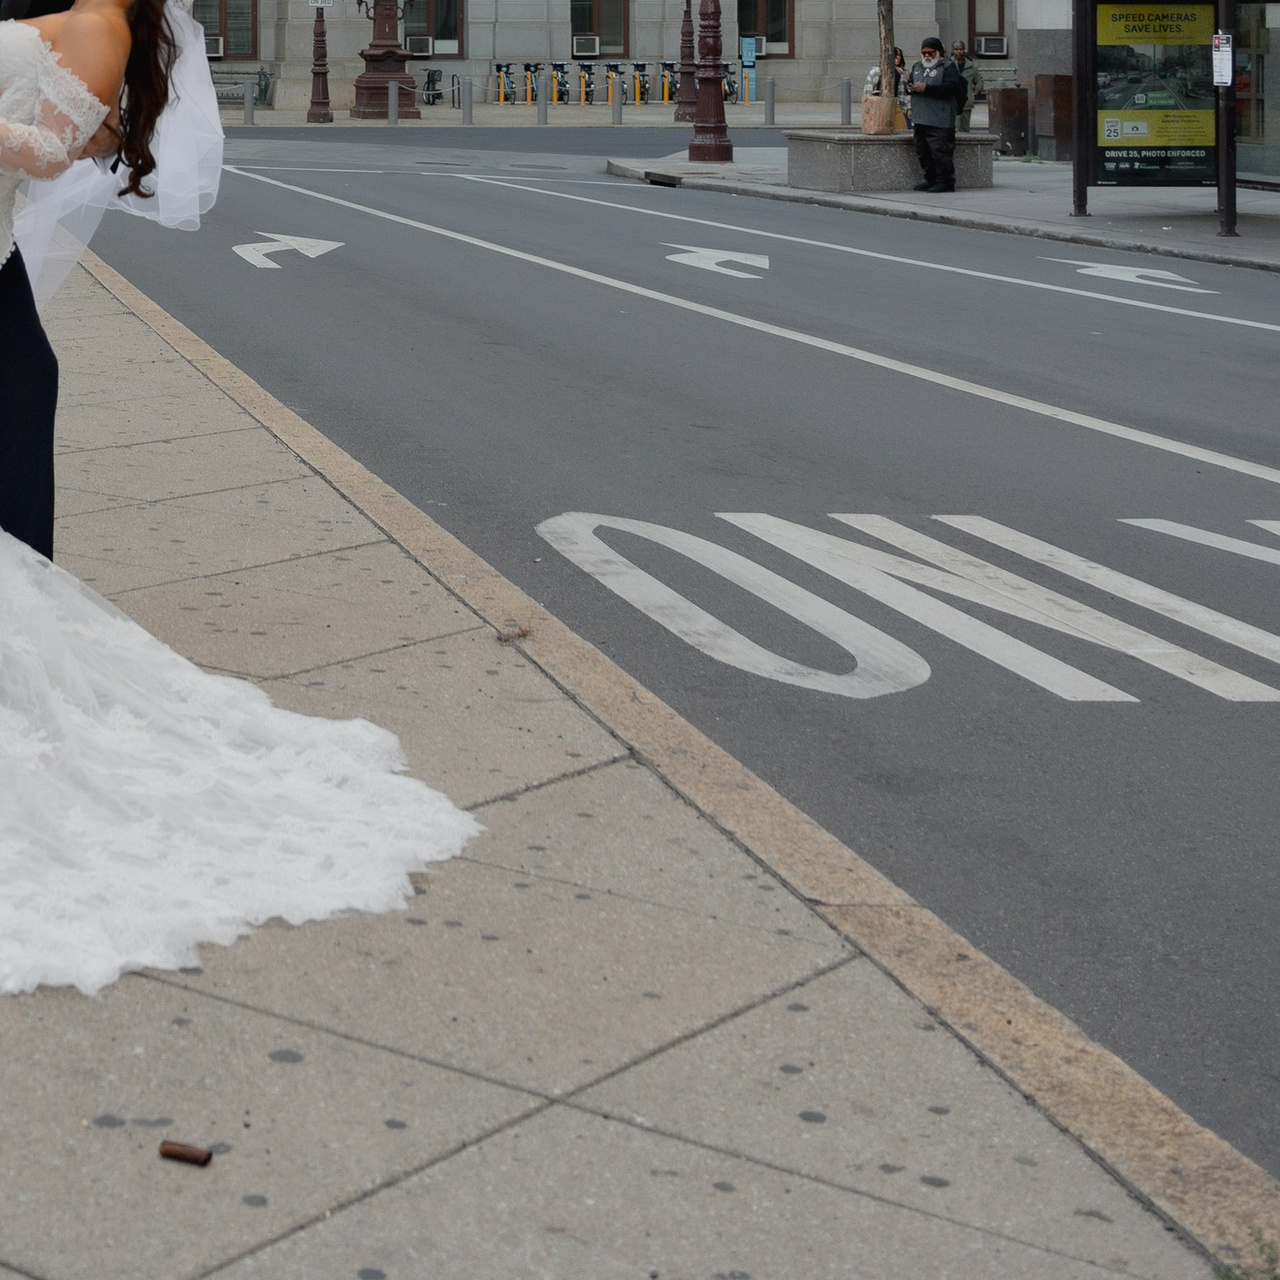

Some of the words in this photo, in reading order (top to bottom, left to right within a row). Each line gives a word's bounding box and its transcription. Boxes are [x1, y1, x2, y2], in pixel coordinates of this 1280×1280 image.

[1111, 13, 1145, 22] SPEED
[1147, 13, 1197, 22] CAMERAS
[1124, 24, 1151, 33] SAVE
[1153, 24, 1184, 33] LIVES.
[1106, 129, 1119, 138] 25
[1105, 150, 1128, 158] DRIVE
[1129, 150, 1140, 158] 25,
